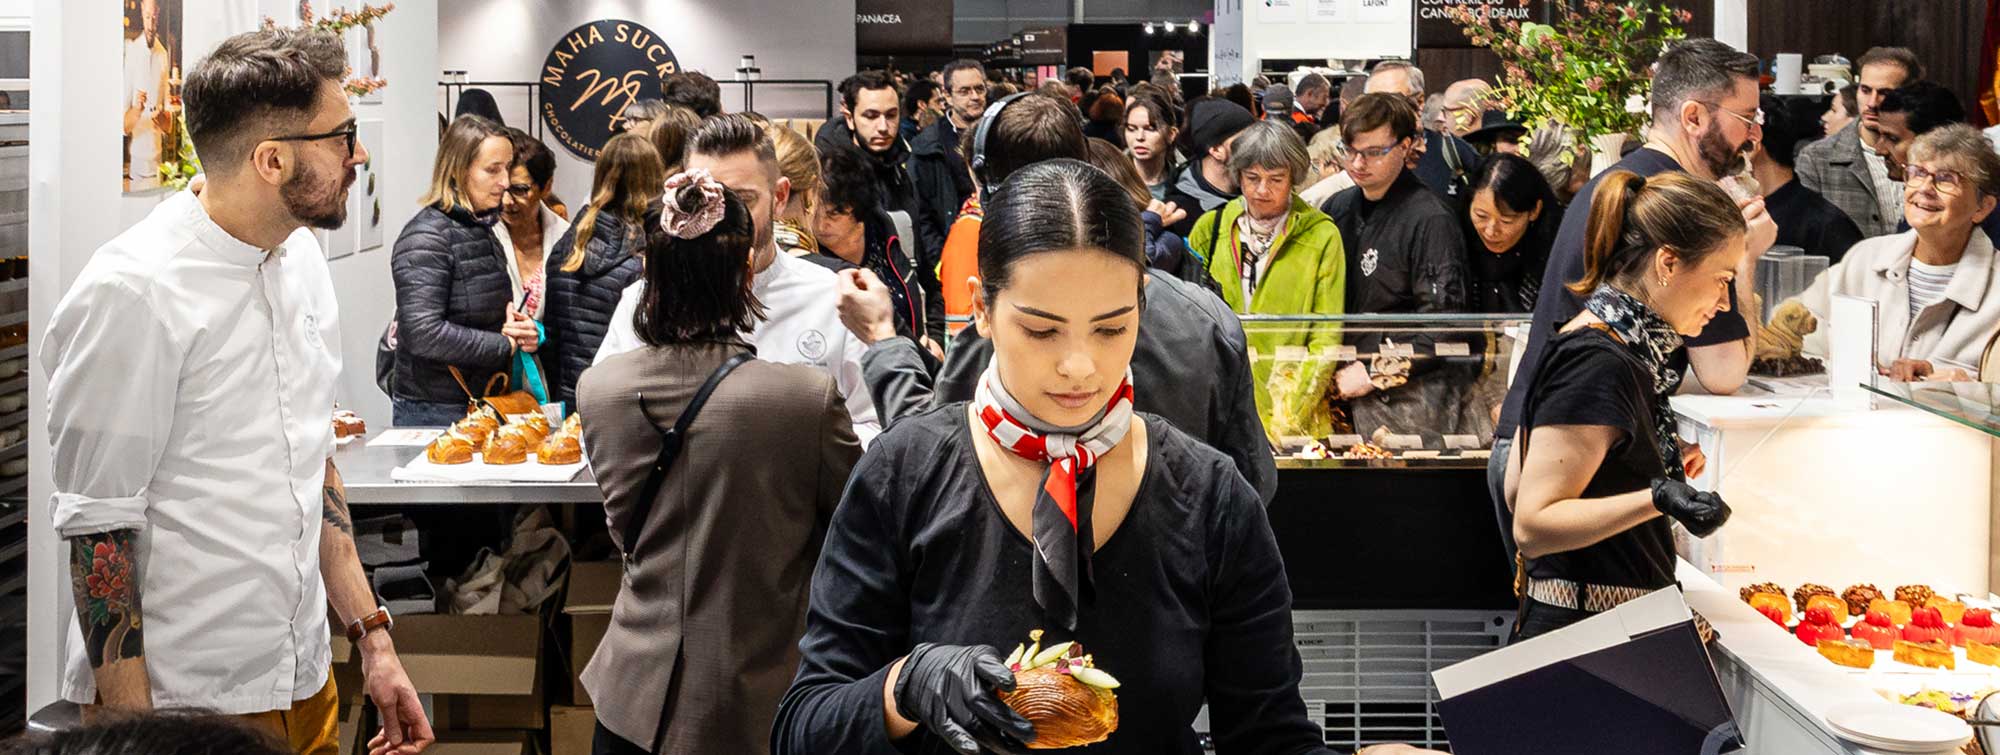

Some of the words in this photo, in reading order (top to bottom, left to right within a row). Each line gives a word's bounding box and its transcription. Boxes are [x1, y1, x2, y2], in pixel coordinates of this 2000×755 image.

[856, 14, 902, 24] PANACEA
[1467, 7, 1530, 19] BODEAUX
[543, 25, 604, 88] MAHA
